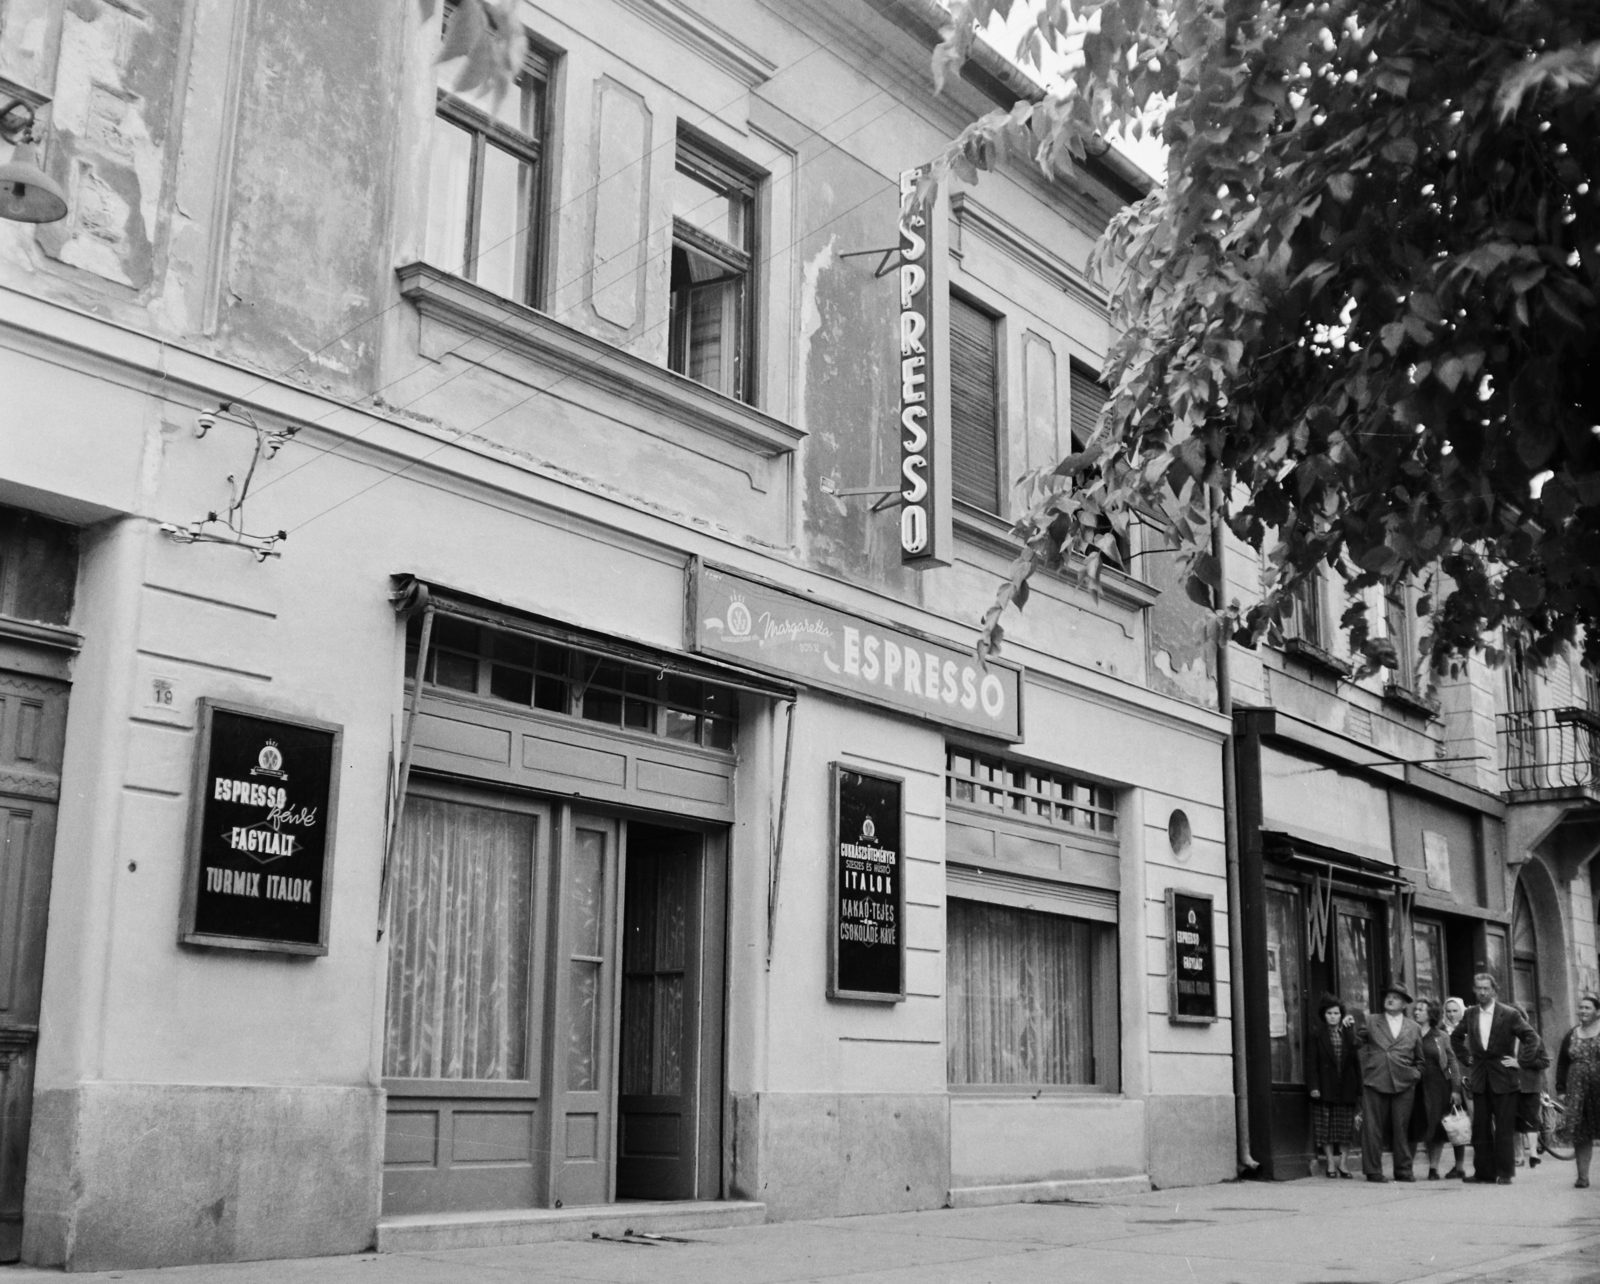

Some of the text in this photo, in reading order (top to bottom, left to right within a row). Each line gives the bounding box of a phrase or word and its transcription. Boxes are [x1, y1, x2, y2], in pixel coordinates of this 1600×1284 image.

[899, 168, 927, 554] ESPRESSO
[843, 625, 1004, 717] ESPRESSO
[214, 777, 287, 809] ESPRESSO
[231, 826, 296, 857] FAGYLALT
[206, 866, 313, 904] TURMIX ITALOK
[845, 870, 892, 894] ITALOK
